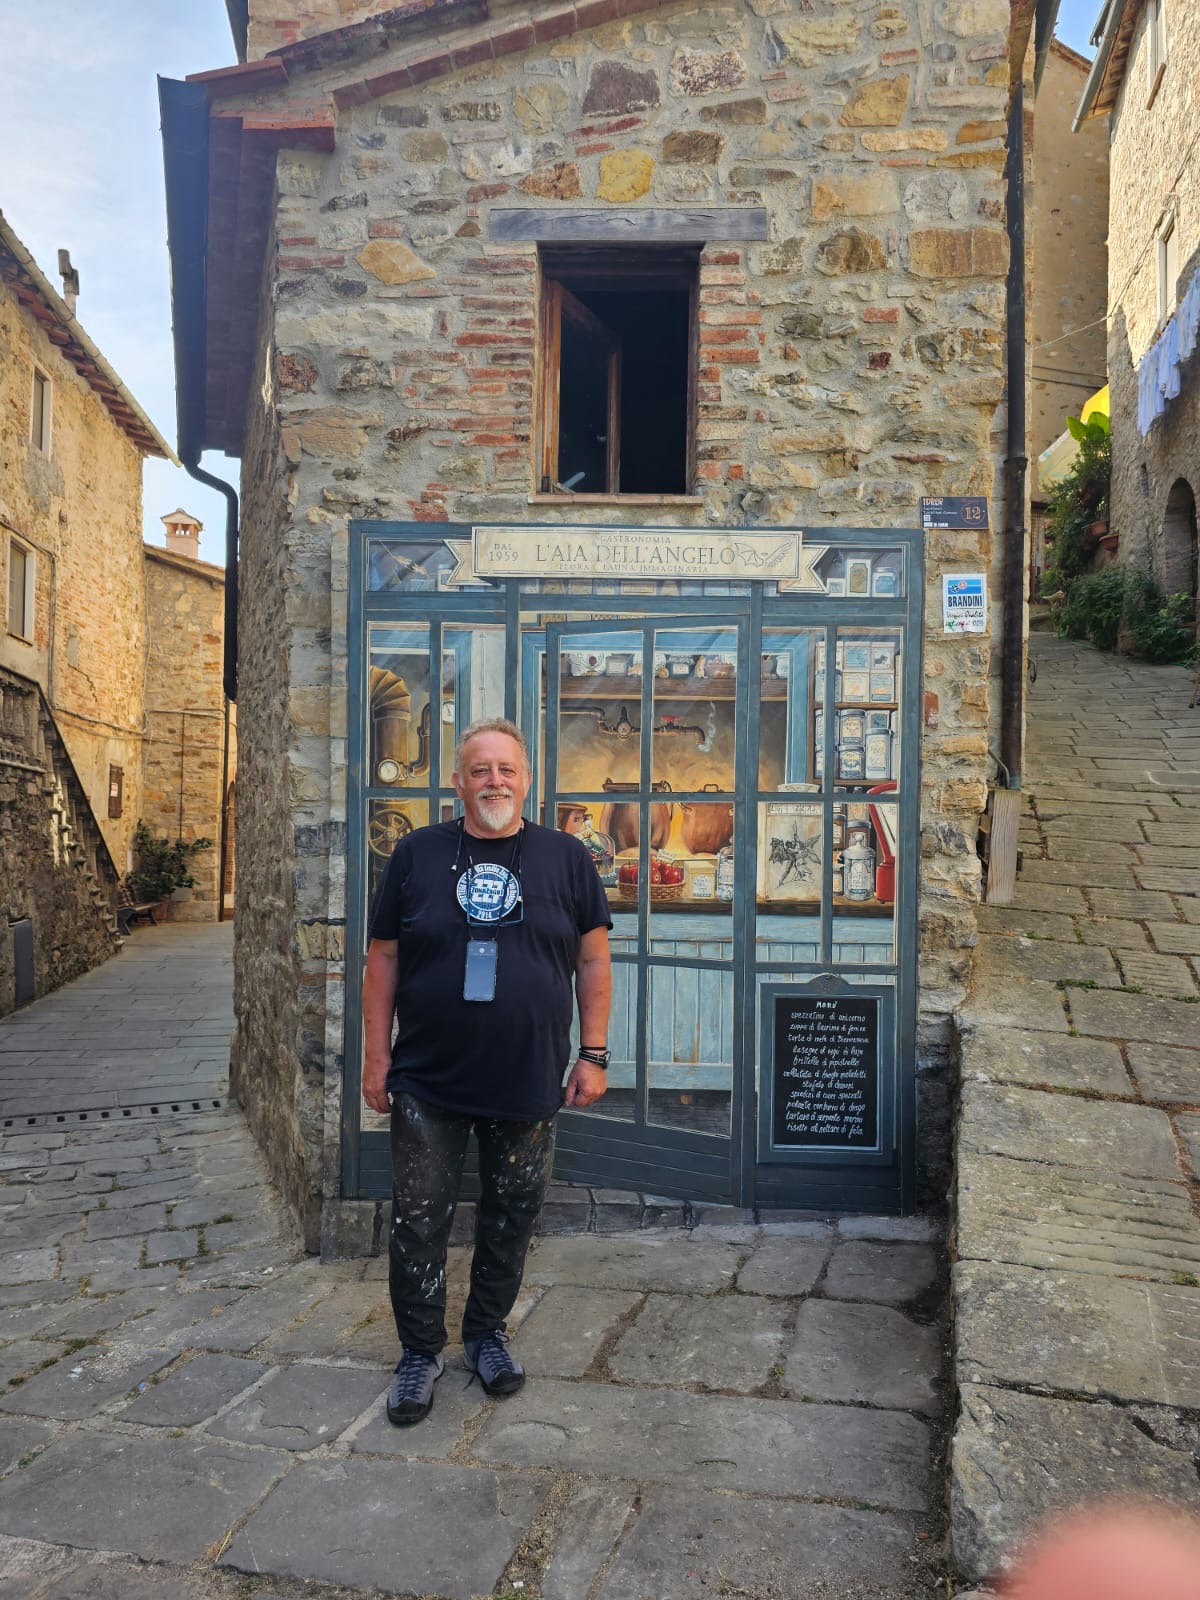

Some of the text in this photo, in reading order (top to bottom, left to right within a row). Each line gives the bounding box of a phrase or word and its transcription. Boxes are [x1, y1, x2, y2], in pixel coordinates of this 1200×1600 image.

[964, 506, 981, 520] 12
[600, 535, 671, 544] GASTRONOMIA
[494, 543, 513, 551] DAL
[488, 551, 519, 562] 1959
[535, 544, 736, 565] L'AIA DELL'ANGELO
[559, 563, 589, 571] FLORA
[602, 563, 635, 572] FAUNA
[639, 564, 709, 573] IMMAGINARIA
[947, 595, 983, 608] BRANDINI
